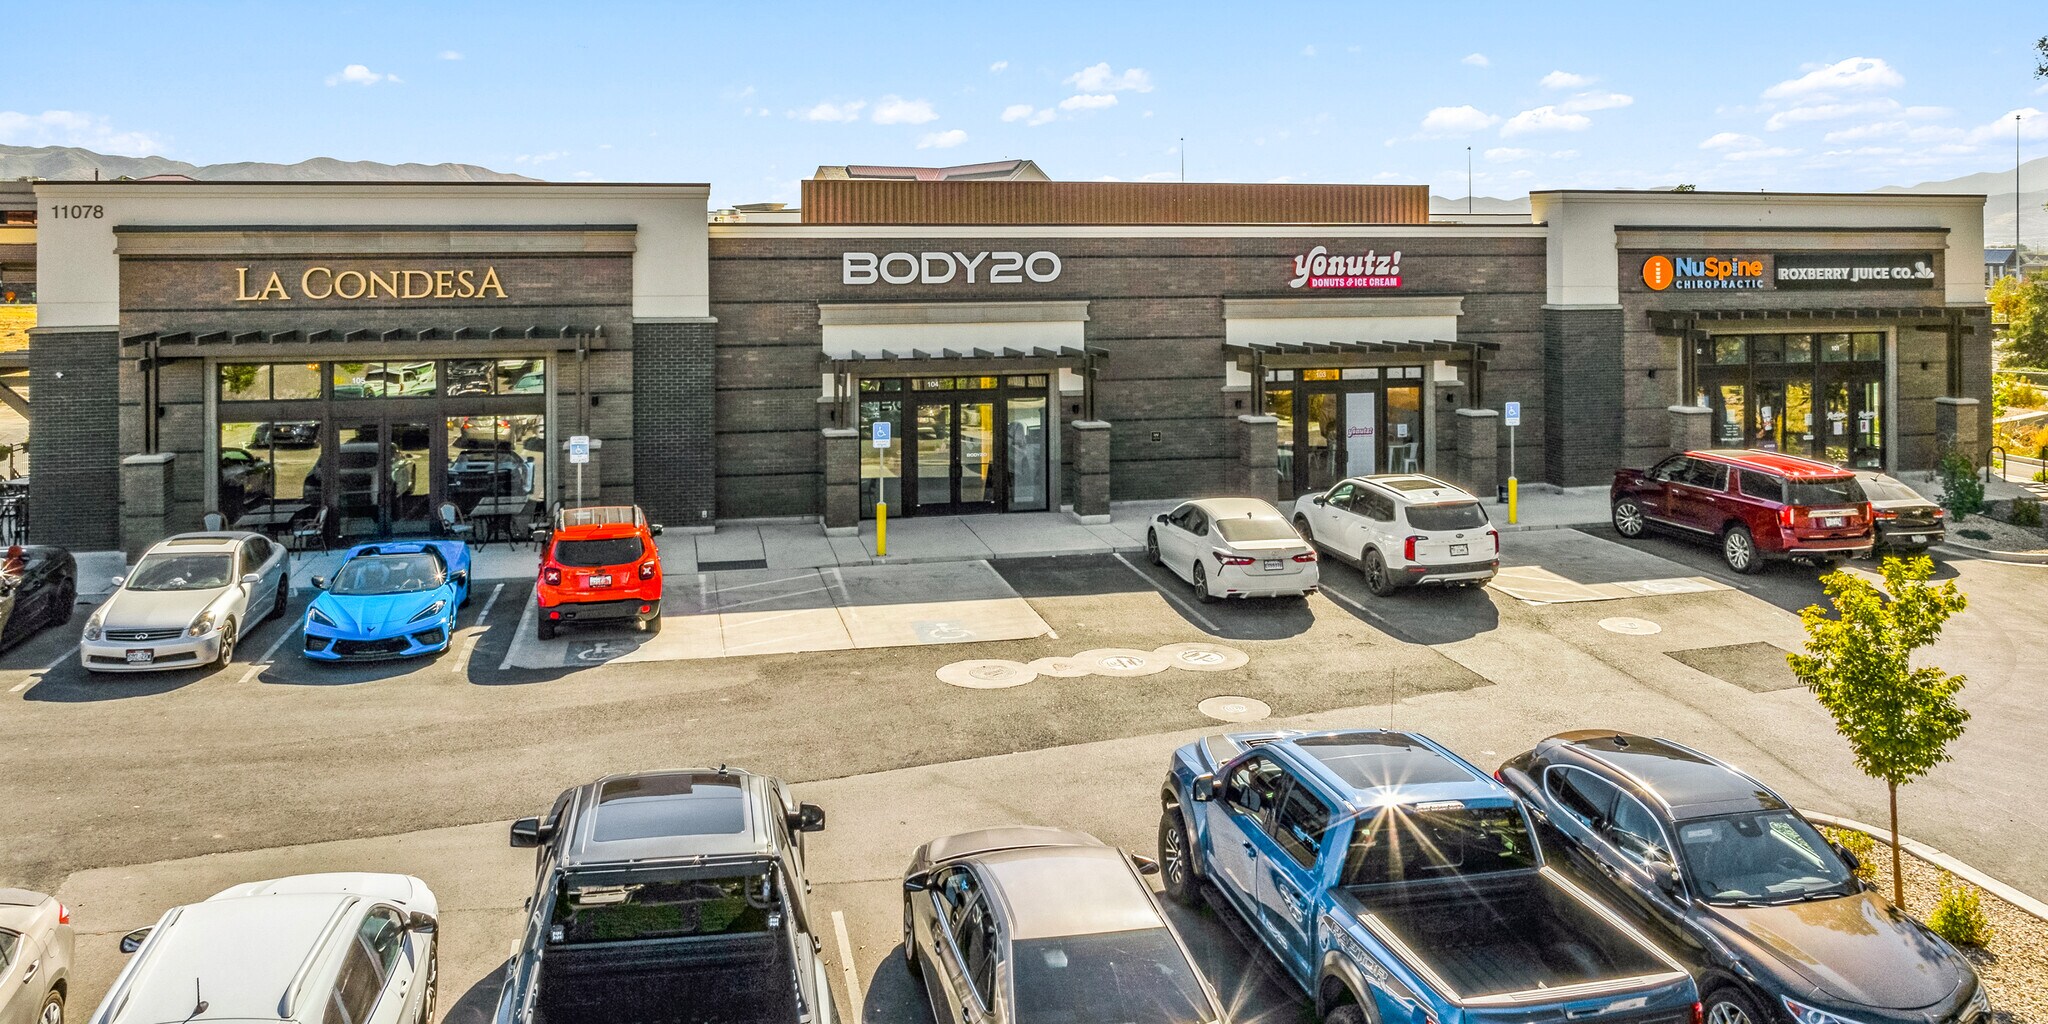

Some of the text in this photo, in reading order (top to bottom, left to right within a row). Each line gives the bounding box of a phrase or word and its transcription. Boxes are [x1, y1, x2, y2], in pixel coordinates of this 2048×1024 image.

[51, 205, 104, 219] 11078
[843, 251, 1062, 285] BODY20
[1675, 256, 1763, 281] NuSpine
[1778, 267, 1915, 282] ROXBERRY JUICE CO.
[1311, 277, 1397, 287] DONUTS & ICE CREAM
[1675, 279, 1764, 289] CHIROPRACTIC
[352, 377, 366, 385] 105
